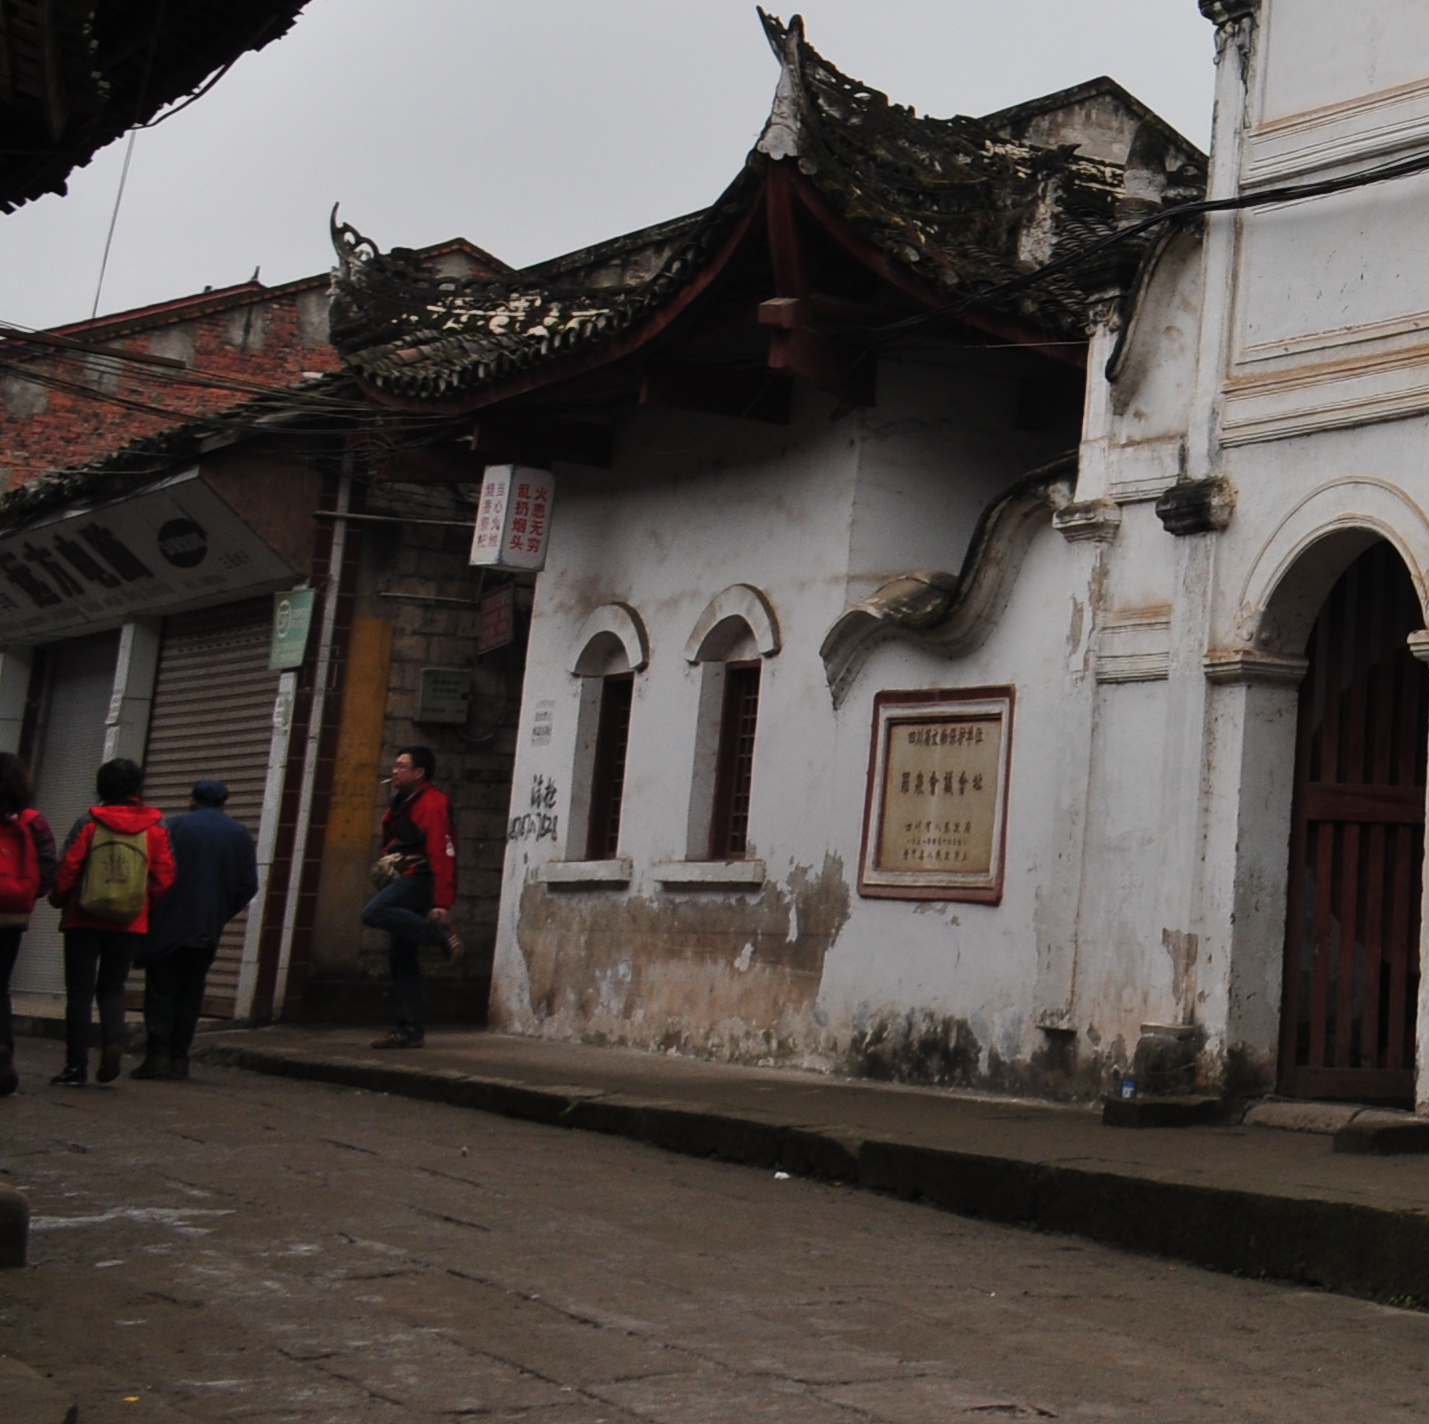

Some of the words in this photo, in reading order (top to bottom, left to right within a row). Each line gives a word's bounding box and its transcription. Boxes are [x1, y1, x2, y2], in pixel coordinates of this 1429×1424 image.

[509, 483, 531, 551] 乱扔烟头
[527, 486, 549, 554] 火患无穷
[907, 726, 985, 748] 四川省文物保护单位
